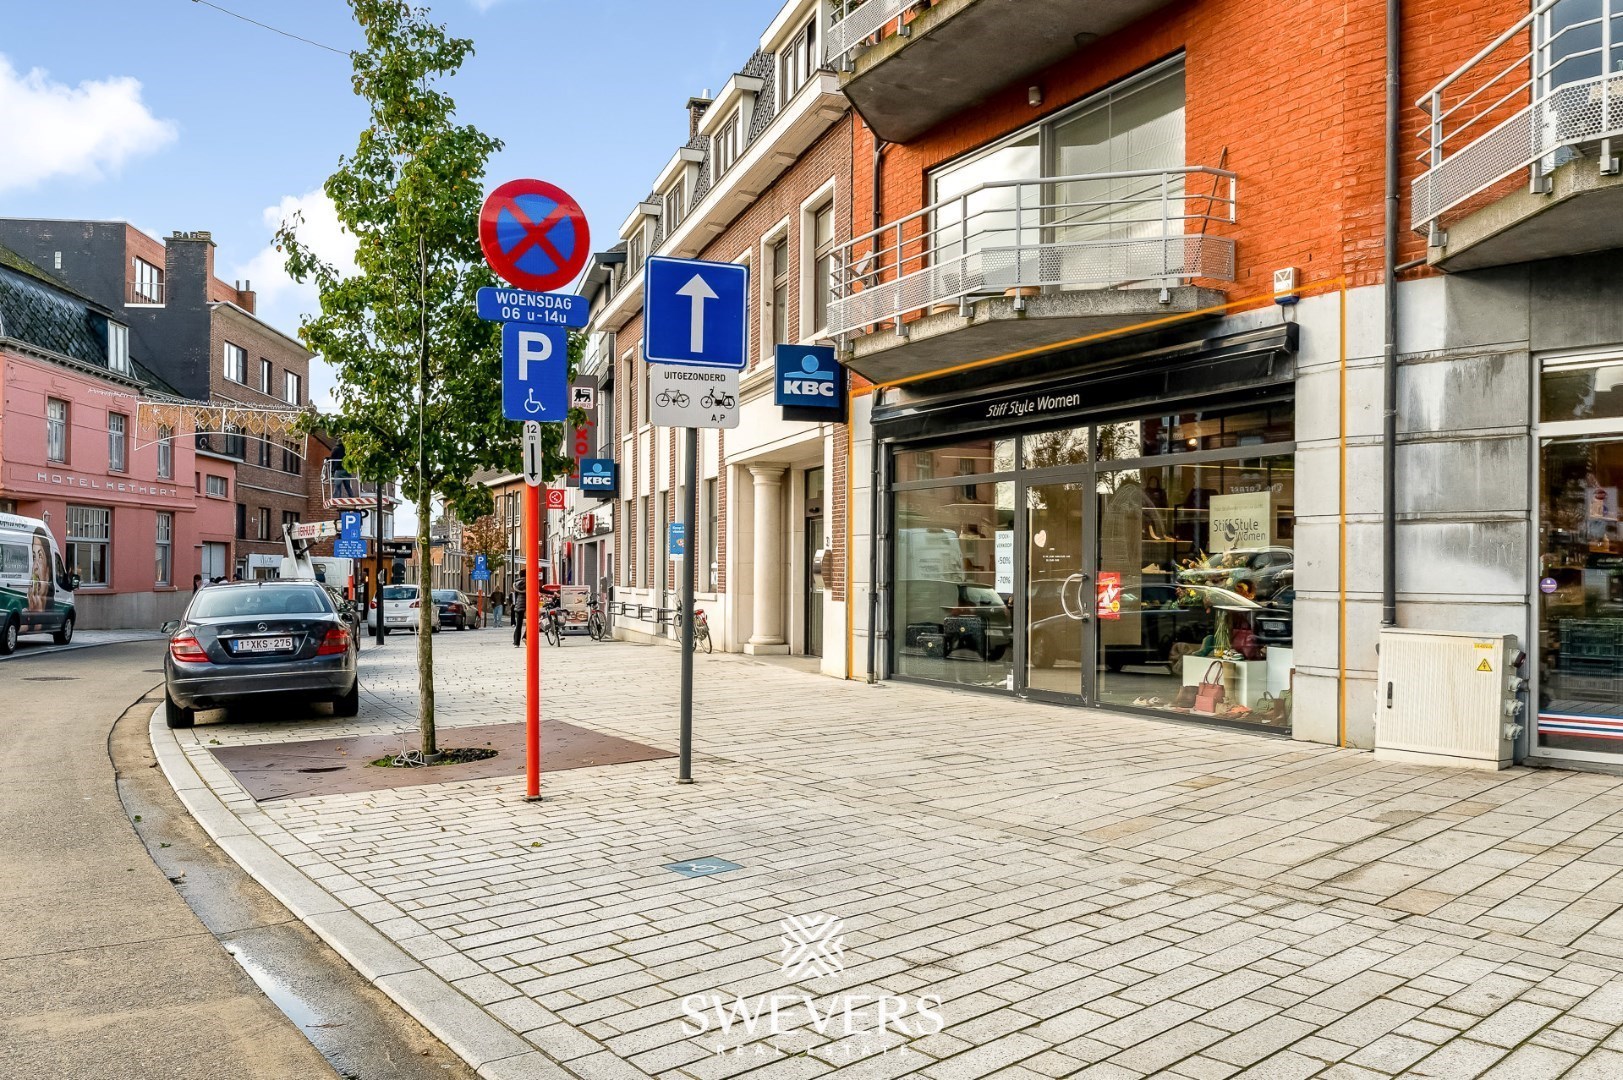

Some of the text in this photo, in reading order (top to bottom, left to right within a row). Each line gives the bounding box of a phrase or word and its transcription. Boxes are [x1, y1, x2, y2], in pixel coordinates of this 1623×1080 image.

[496, 292, 572, 310] WOENSDAG
[501, 307, 520, 320] 06
[518, 331, 553, 382] P
[664, 371, 726, 382] UITGEZONDERD
[783, 380, 834, 397] KBC
[985, 393, 1080, 418] Stiff Style Women
[526, 424, 537, 434] 12
[37, 471, 100, 488] HOTEL
[583, 476, 611, 485] KBC
[345, 515, 356, 530] P
[1213, 518, 1259, 534] Stiff Style
[1235, 531, 1266, 542] Women
[477, 556, 485, 565] P
